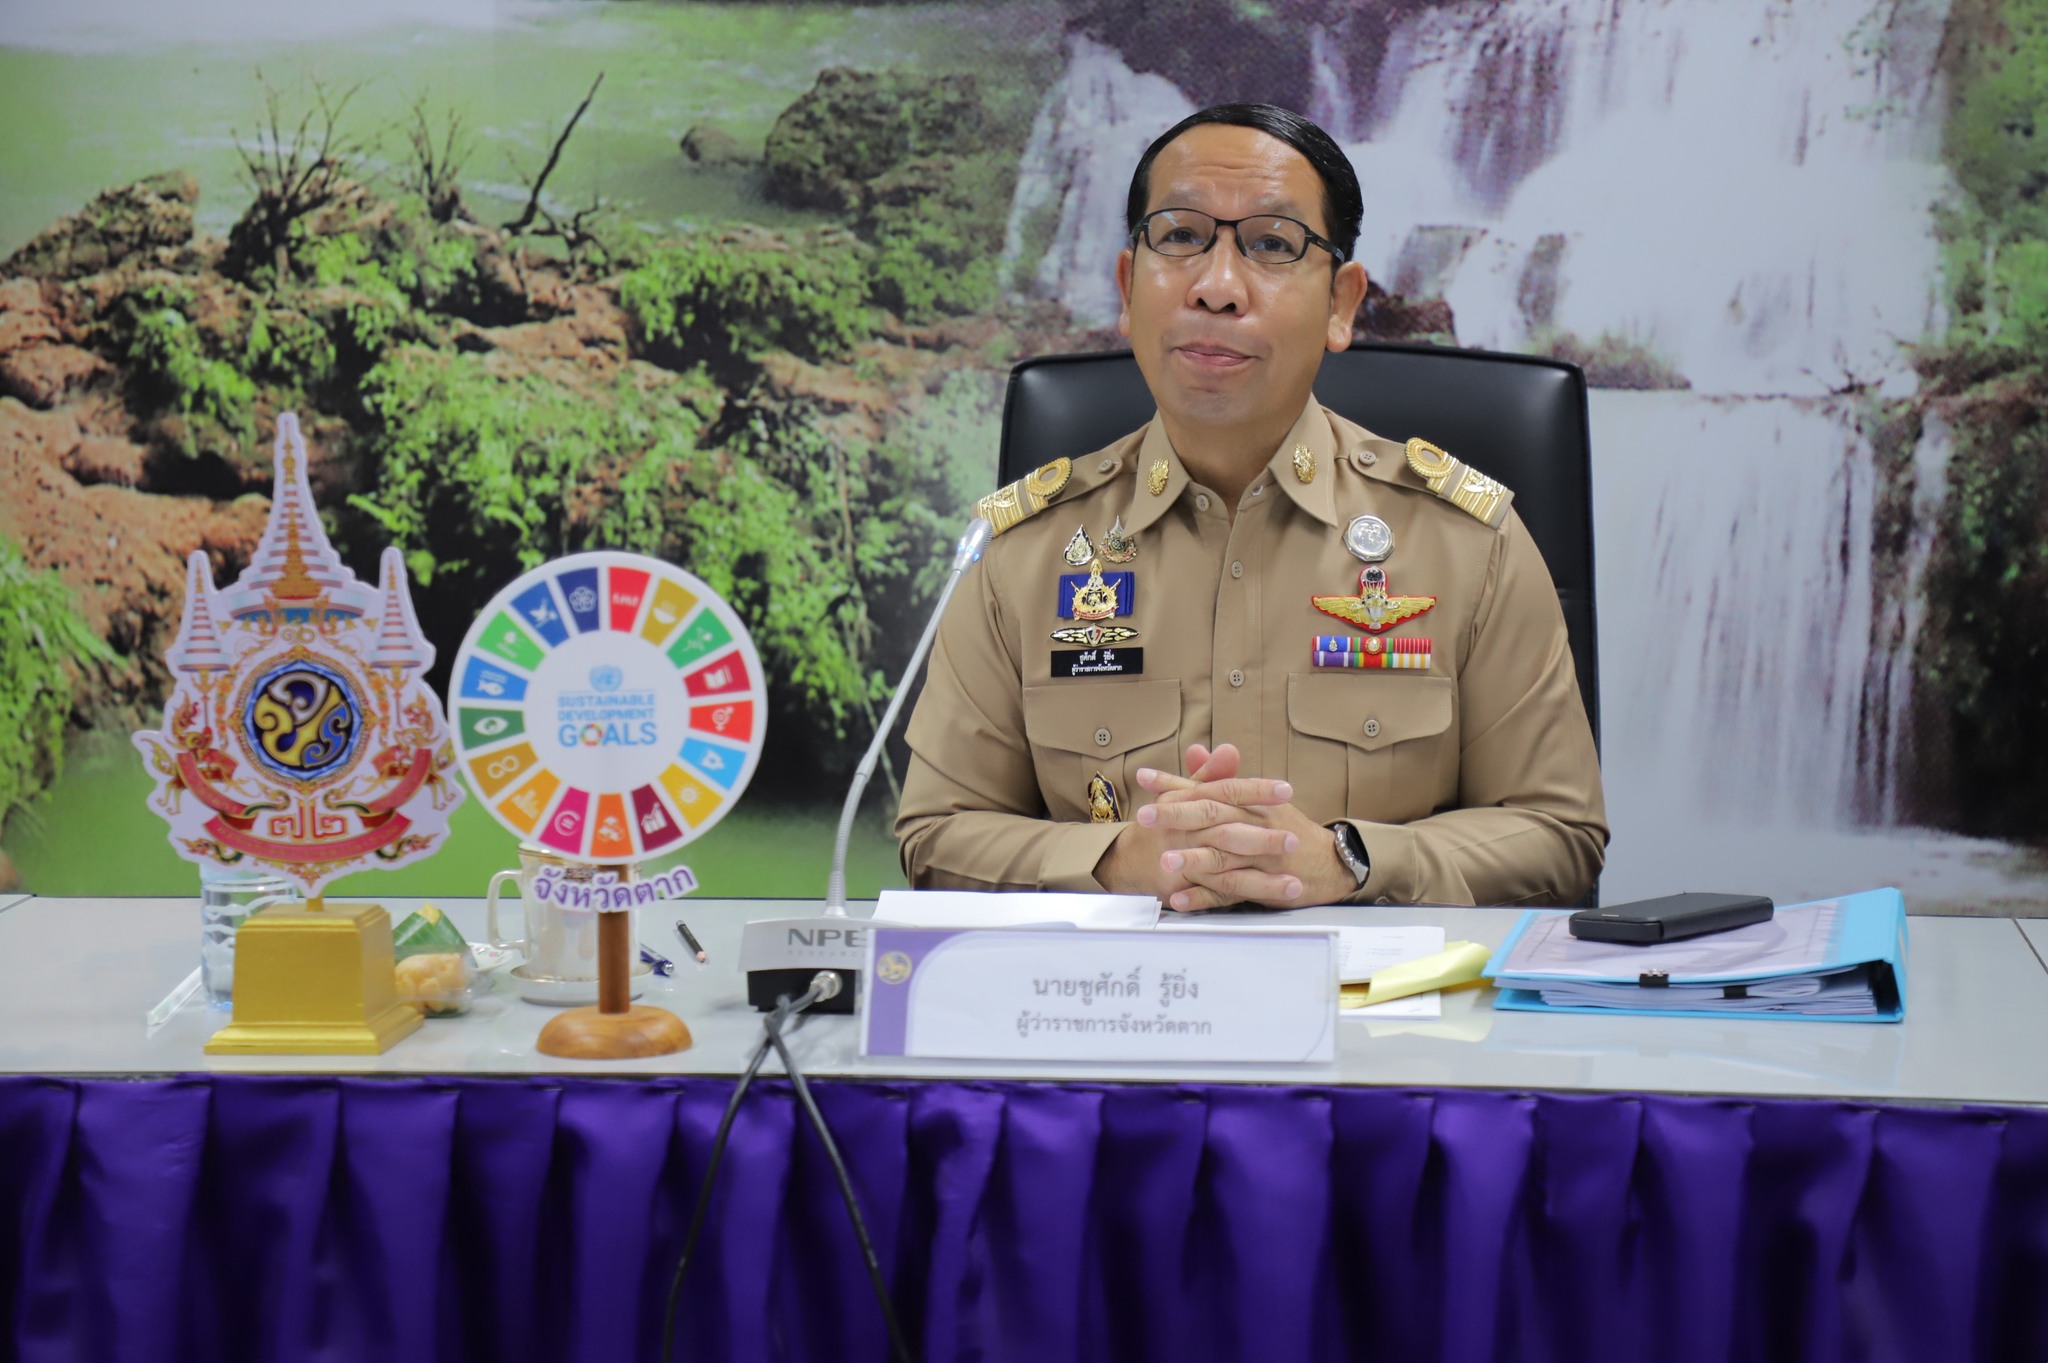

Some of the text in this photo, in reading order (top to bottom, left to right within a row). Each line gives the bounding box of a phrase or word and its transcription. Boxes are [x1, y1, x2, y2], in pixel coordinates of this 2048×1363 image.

[558, 694, 656, 707] SUSTAINABLE
[558, 708, 656, 721] DEVELOPMENT
[558, 721, 658, 748] GOALS
[534, 867, 694, 909] จังหวัดตาก
[1032, 965, 1200, 1008] นายชูศักดิ์ รู้ยิ่ง
[1016, 1010, 1213, 1038] ผู้ว่าราชการจังหวัดตาก
